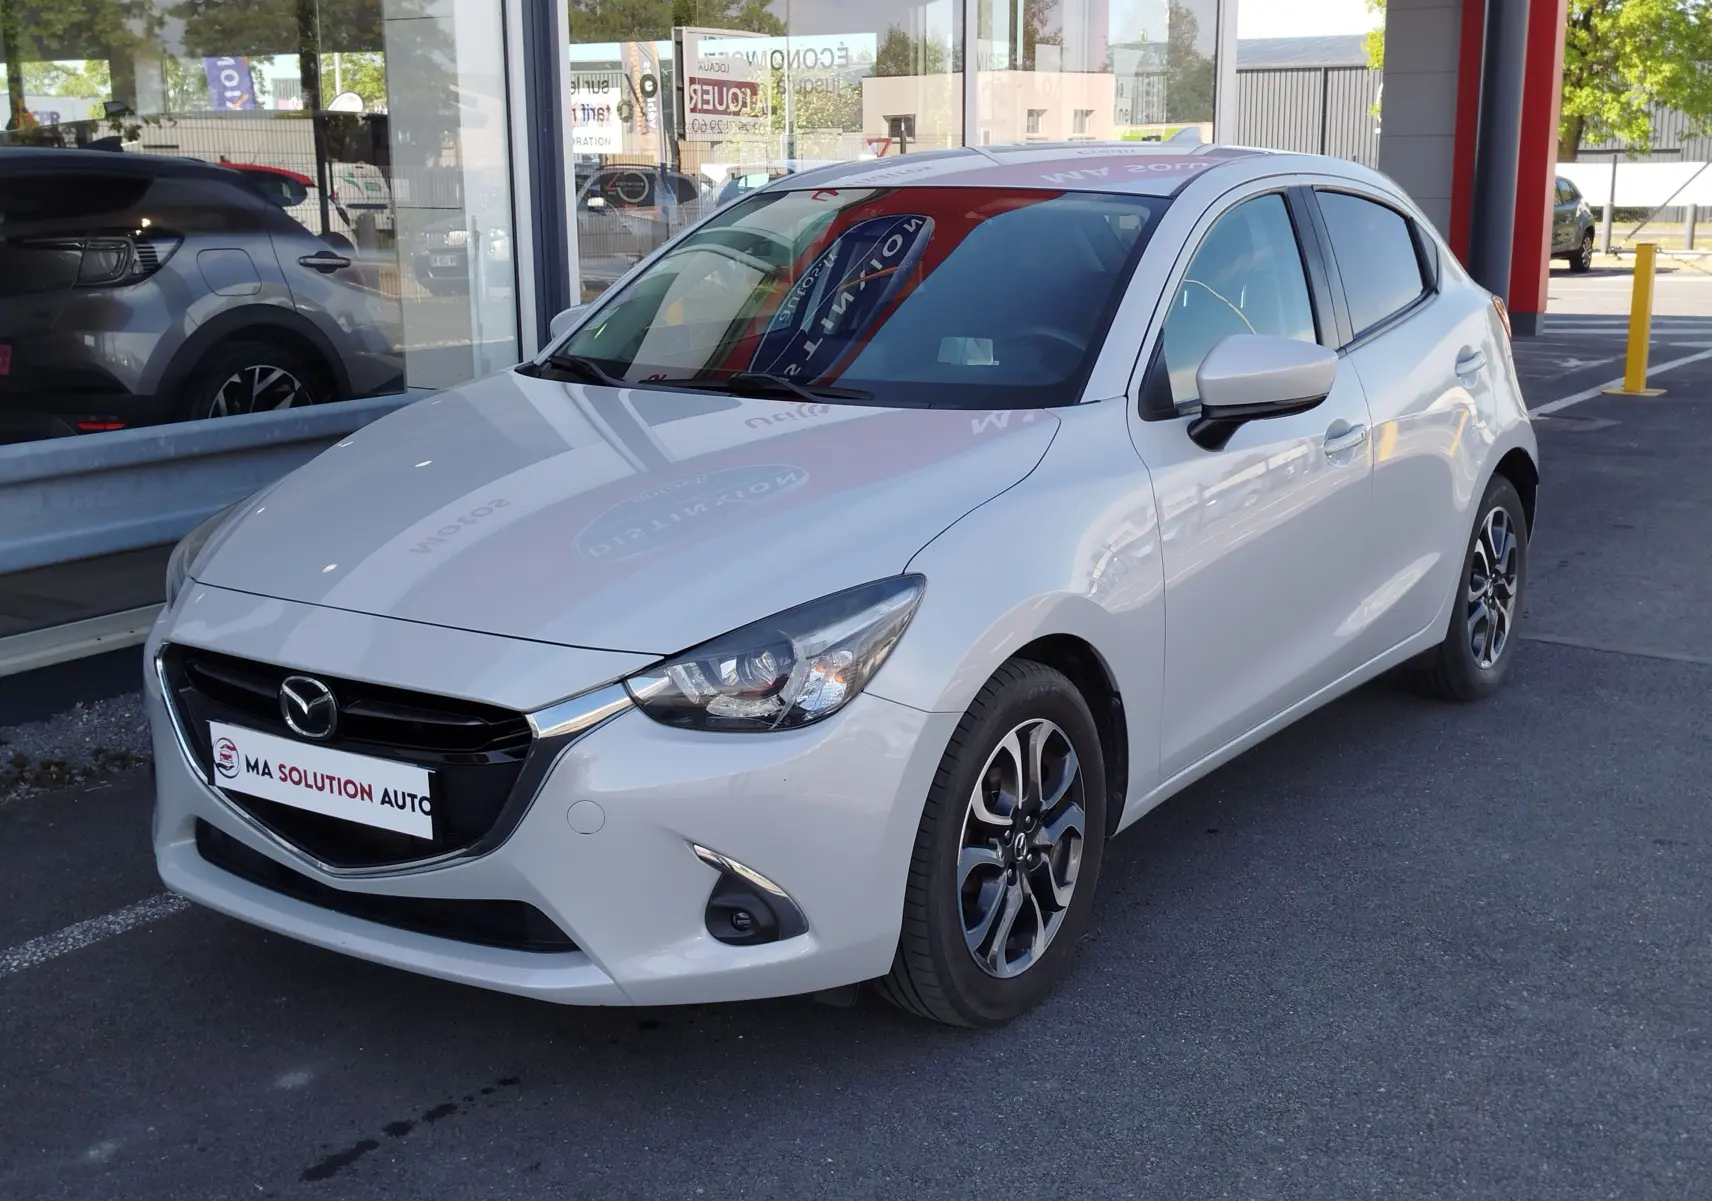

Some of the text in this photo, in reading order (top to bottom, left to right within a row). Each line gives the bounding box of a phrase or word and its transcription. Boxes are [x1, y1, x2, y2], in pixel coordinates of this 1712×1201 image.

[244, 753, 434, 816] MA SOLUTION AUTO
